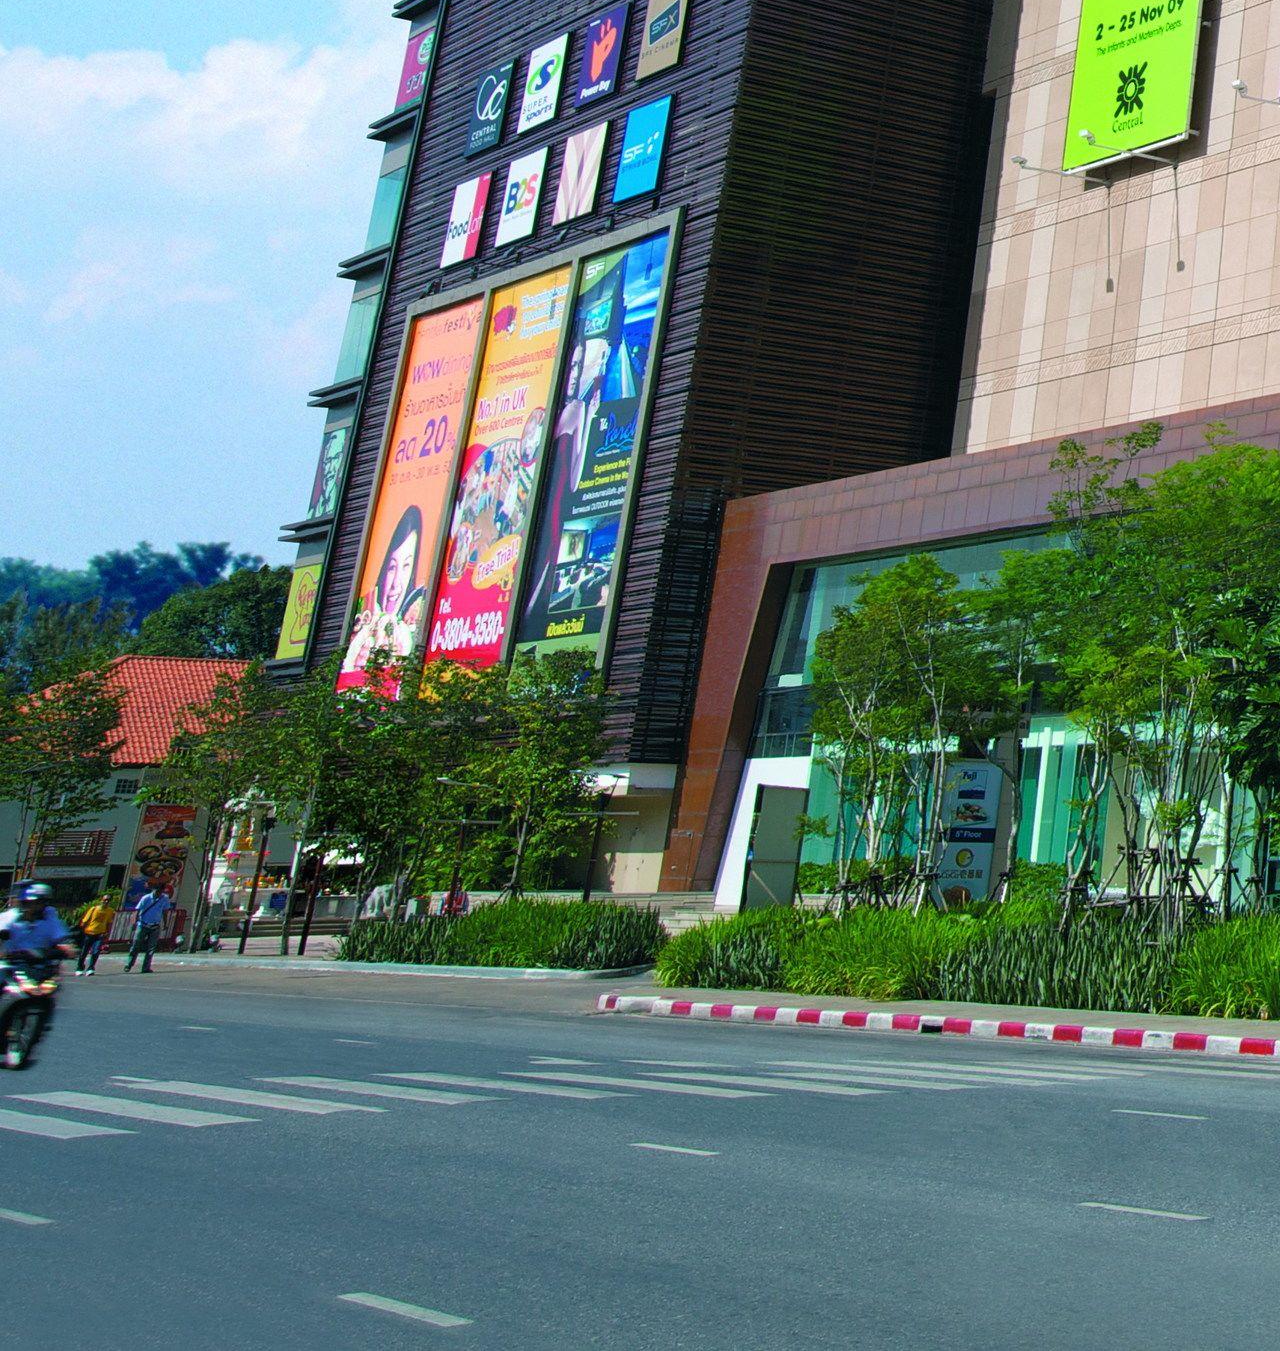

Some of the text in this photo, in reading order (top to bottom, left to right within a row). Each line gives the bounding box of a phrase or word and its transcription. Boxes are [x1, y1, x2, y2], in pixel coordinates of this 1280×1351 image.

[1095, 23, 1104, 41] 2
[1119, 11, 1136, 33] 25
[1139, 4, 1165, 26] Nov
[471, 125, 497, 141] CENTRAL
[1111, 111, 1144, 134] Central
[504, 172, 539, 216] B2S
[512, 387, 528, 410] UK
[476, 560, 494, 583] Free
